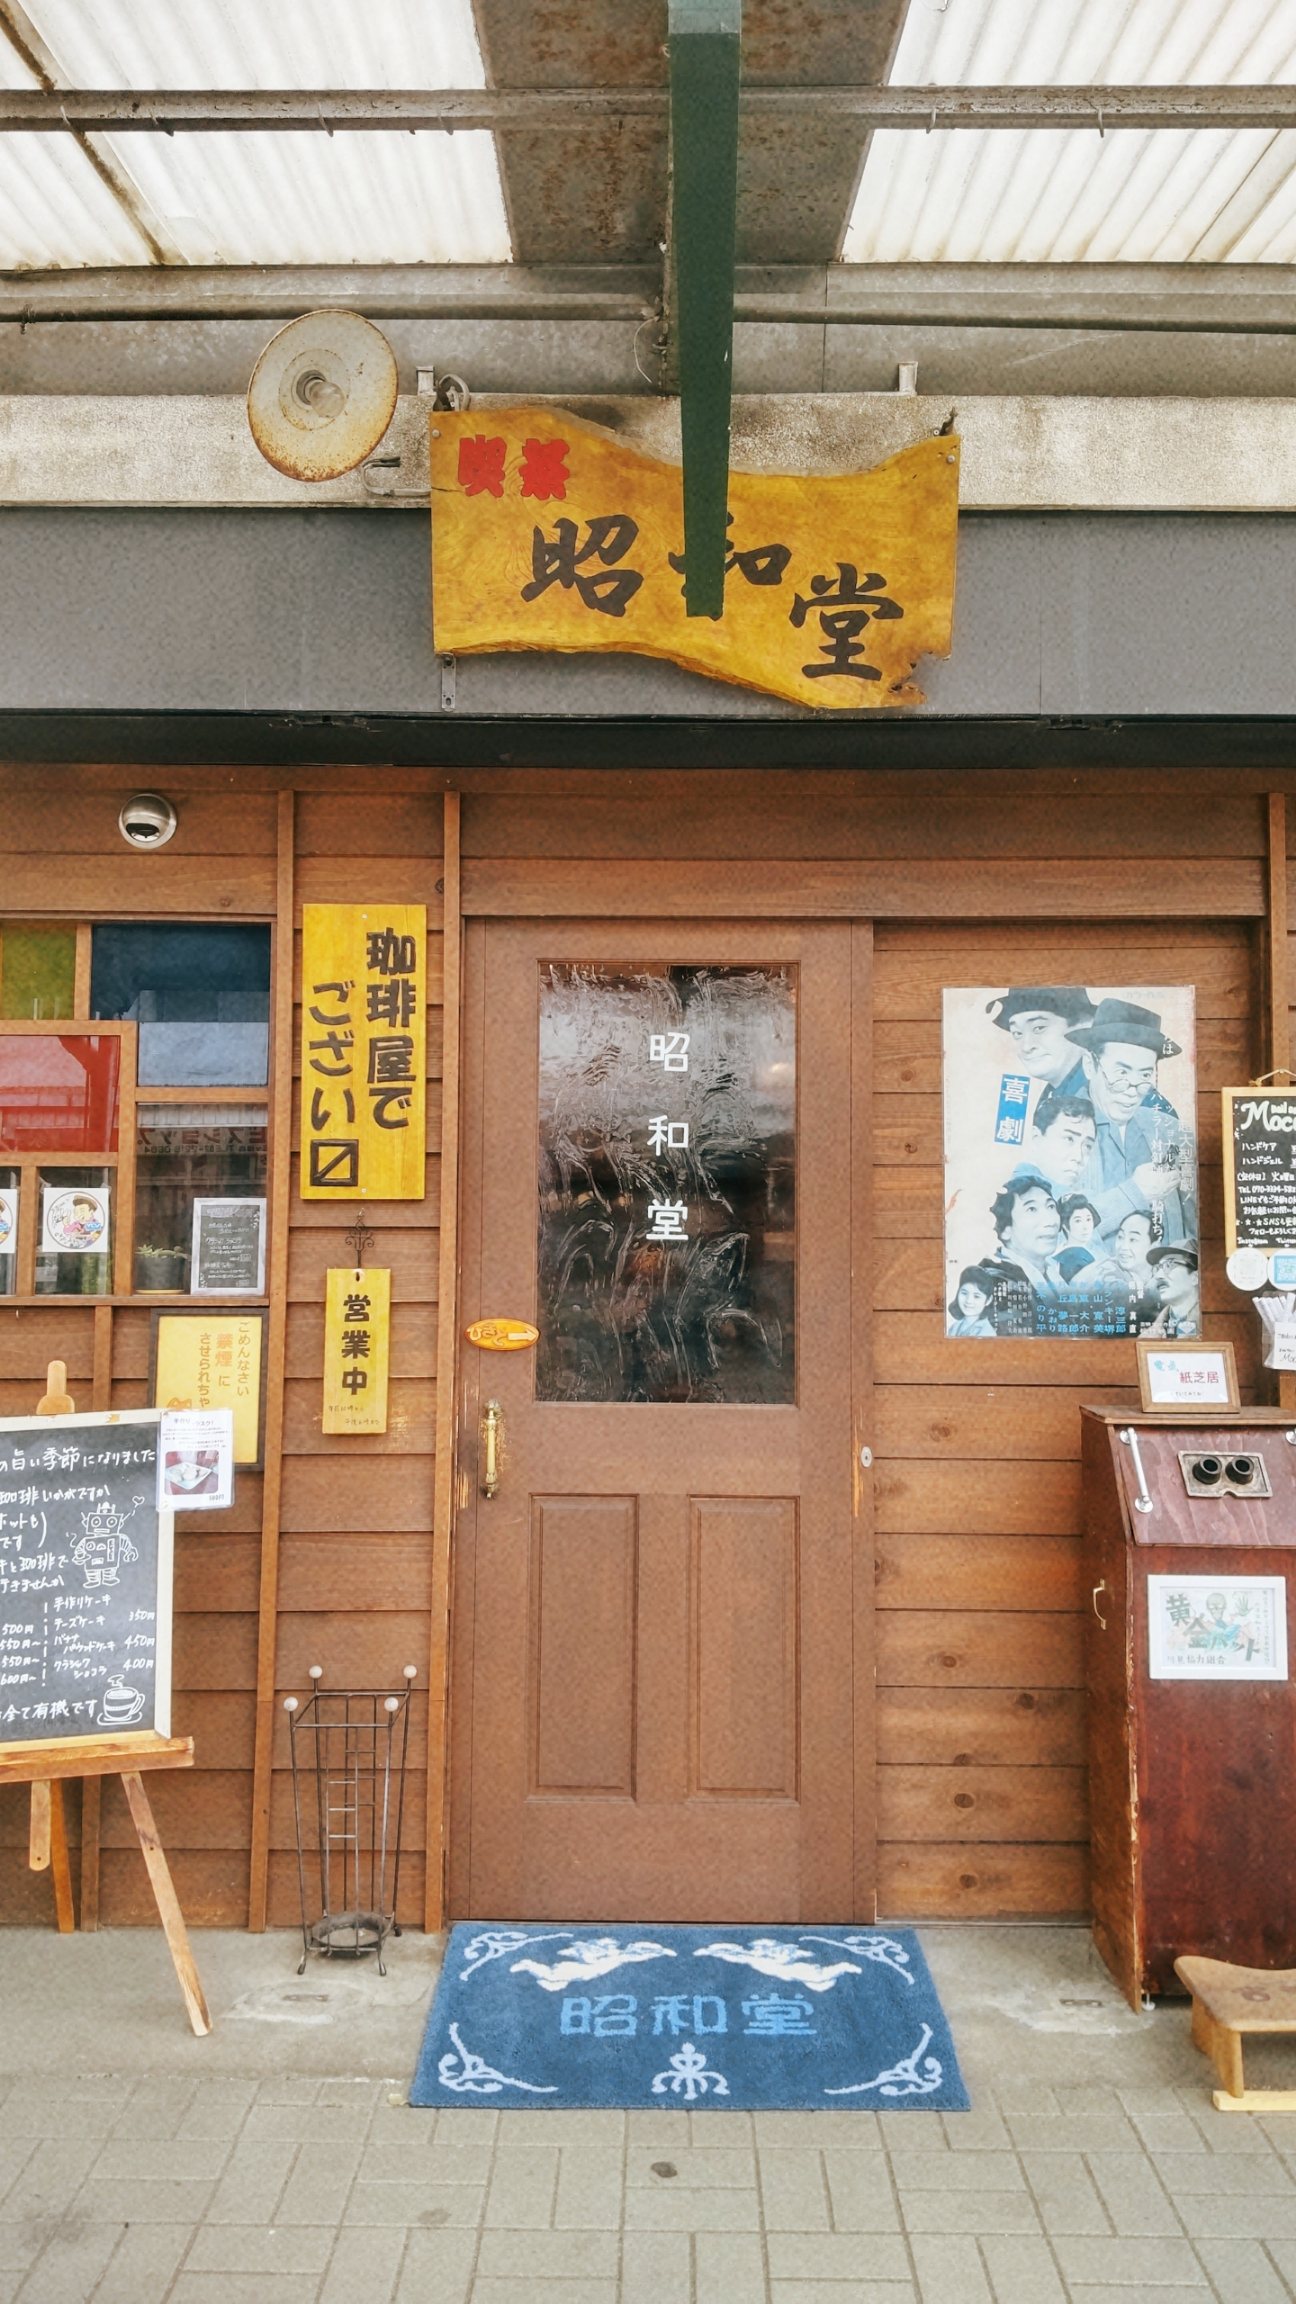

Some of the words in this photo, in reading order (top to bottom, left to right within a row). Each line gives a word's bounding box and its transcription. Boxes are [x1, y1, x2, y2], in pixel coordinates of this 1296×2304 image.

[366, 926, 417, 1131] 珈琲屋で
[996, 1077, 1029, 1143] 喜劇
[646, 1032, 691, 1241] 昭和堂
[342, 1294, 372, 1396] 営業中
[215, 1333, 233, 1387] 禁煙に
[238, 1320, 251, 1397] ごめんなさい
[1179, 1371, 1220, 1385] 紙芝居
[53, 1594, 111, 1612] 手作りケーキ
[2, 1623, 34, 1635] 500円
[53, 1615, 106, 1631] チーズケーキ
[53, 1633, 80, 1646] バナナ
[124, 1633, 155, 1650] 450円
[122, 1658, 155, 1672] 400円
[0, 1699, 98, 1722] 全て有機です
[559, 1993, 818, 2038] 昭和堂
